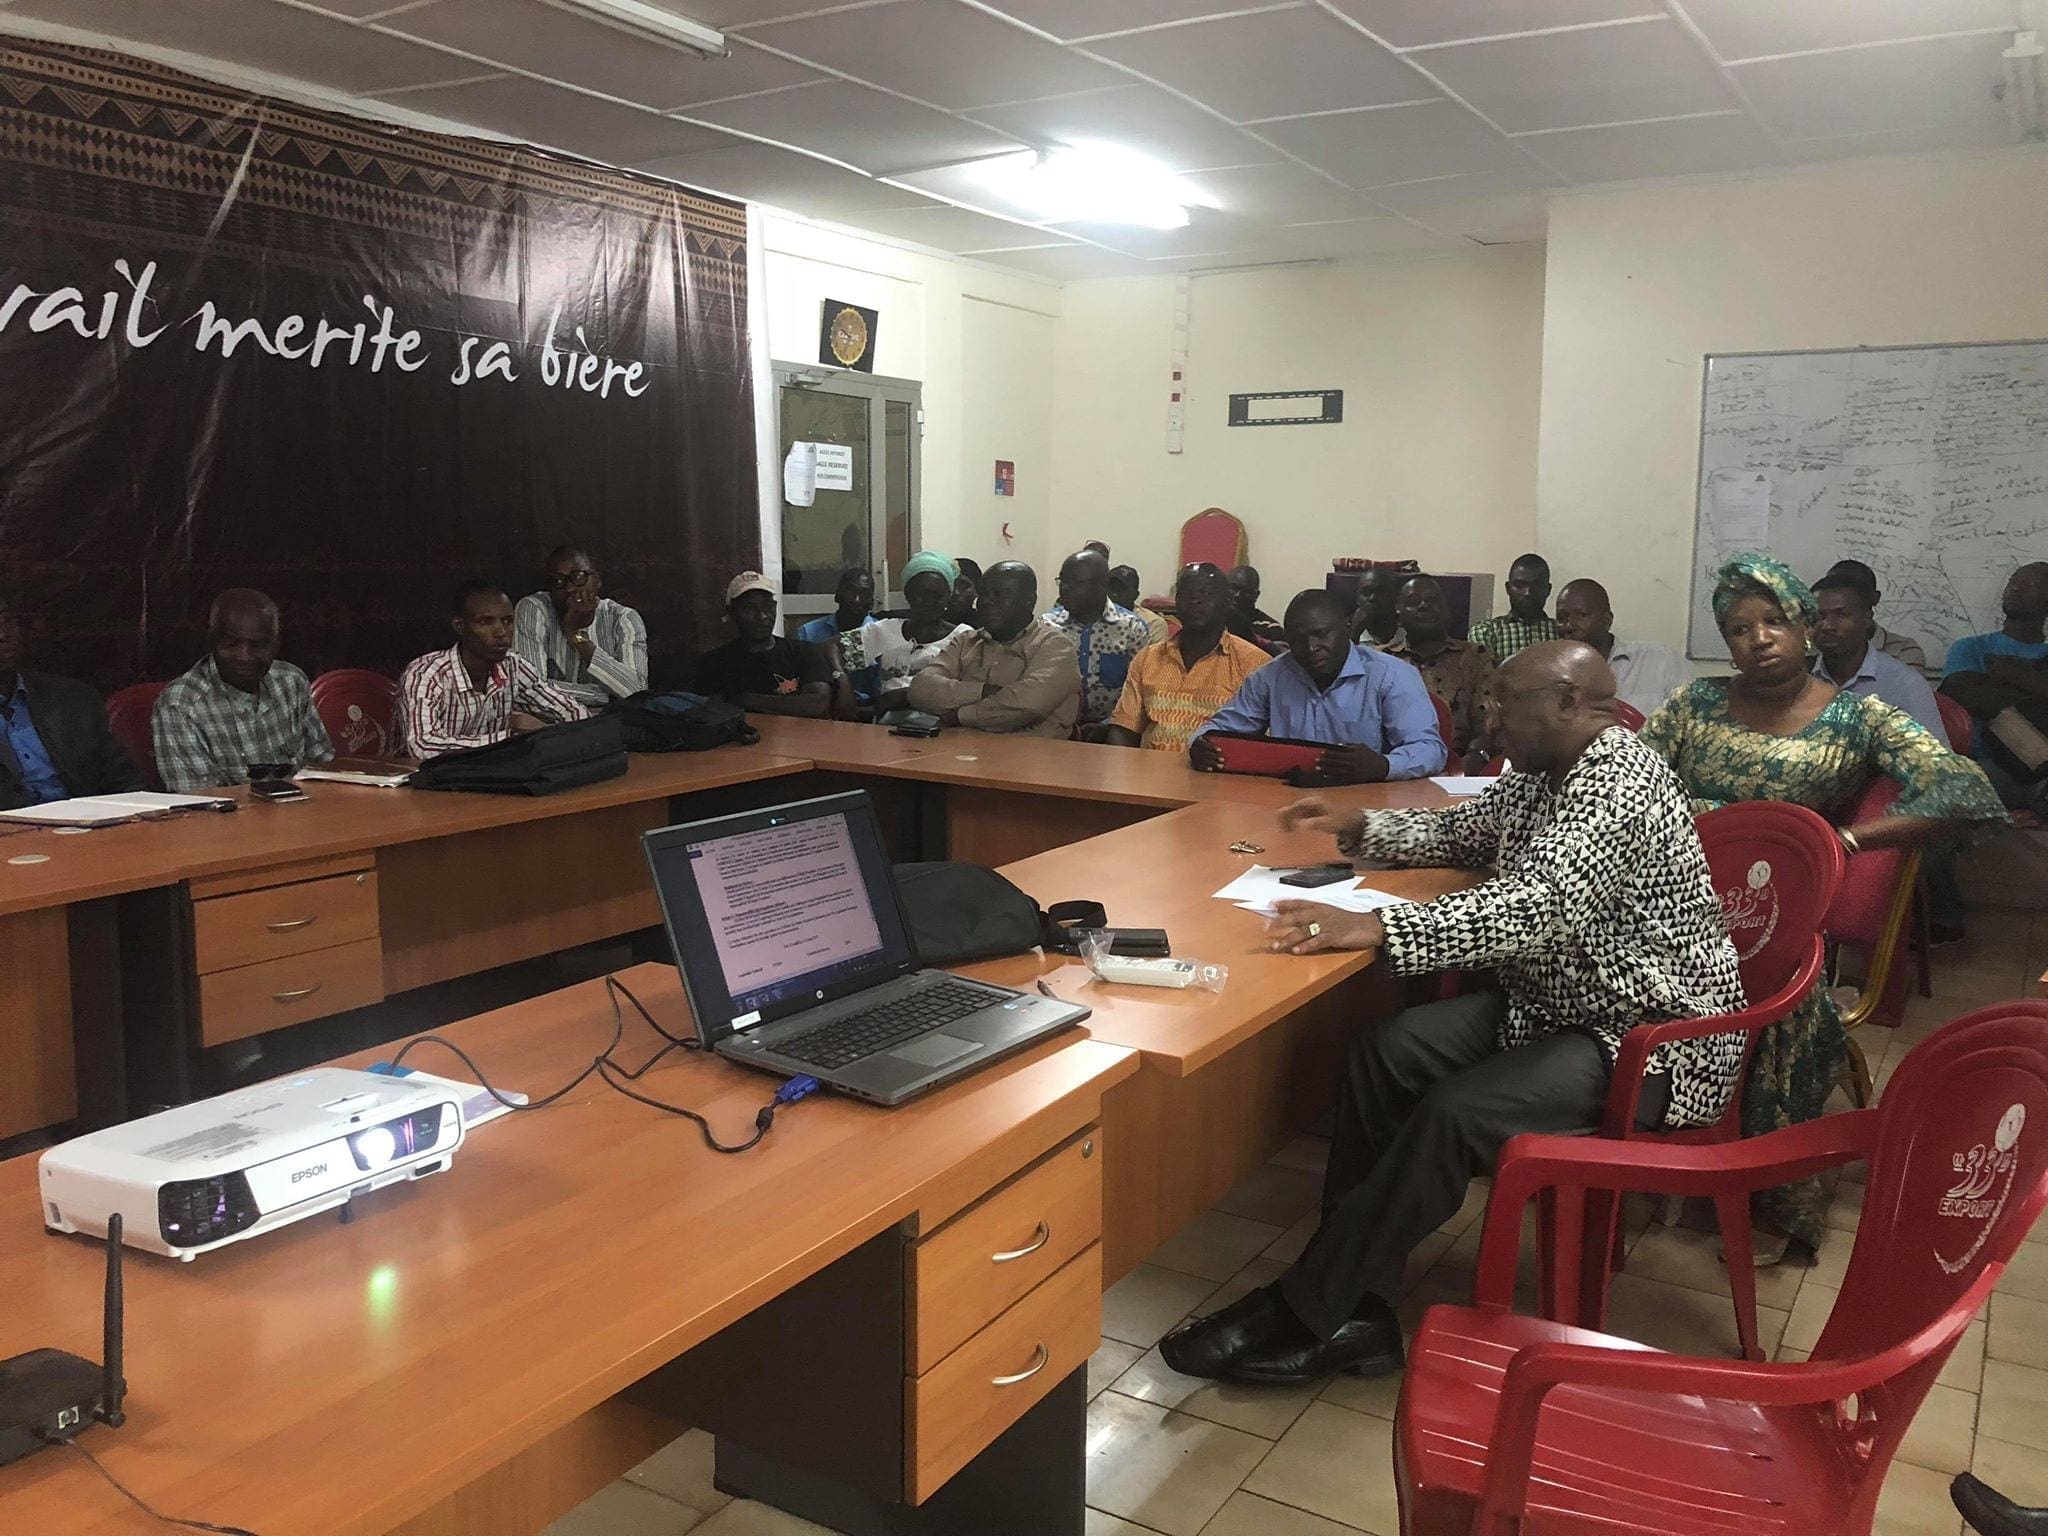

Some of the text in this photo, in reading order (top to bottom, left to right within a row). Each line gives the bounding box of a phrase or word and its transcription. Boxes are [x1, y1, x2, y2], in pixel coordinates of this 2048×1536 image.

[181, 294, 430, 373] merite
[451, 337, 520, 386] sa
[291, 1163, 328, 1184] EPSON
[1938, 1198, 1996, 1218] EXPORT
